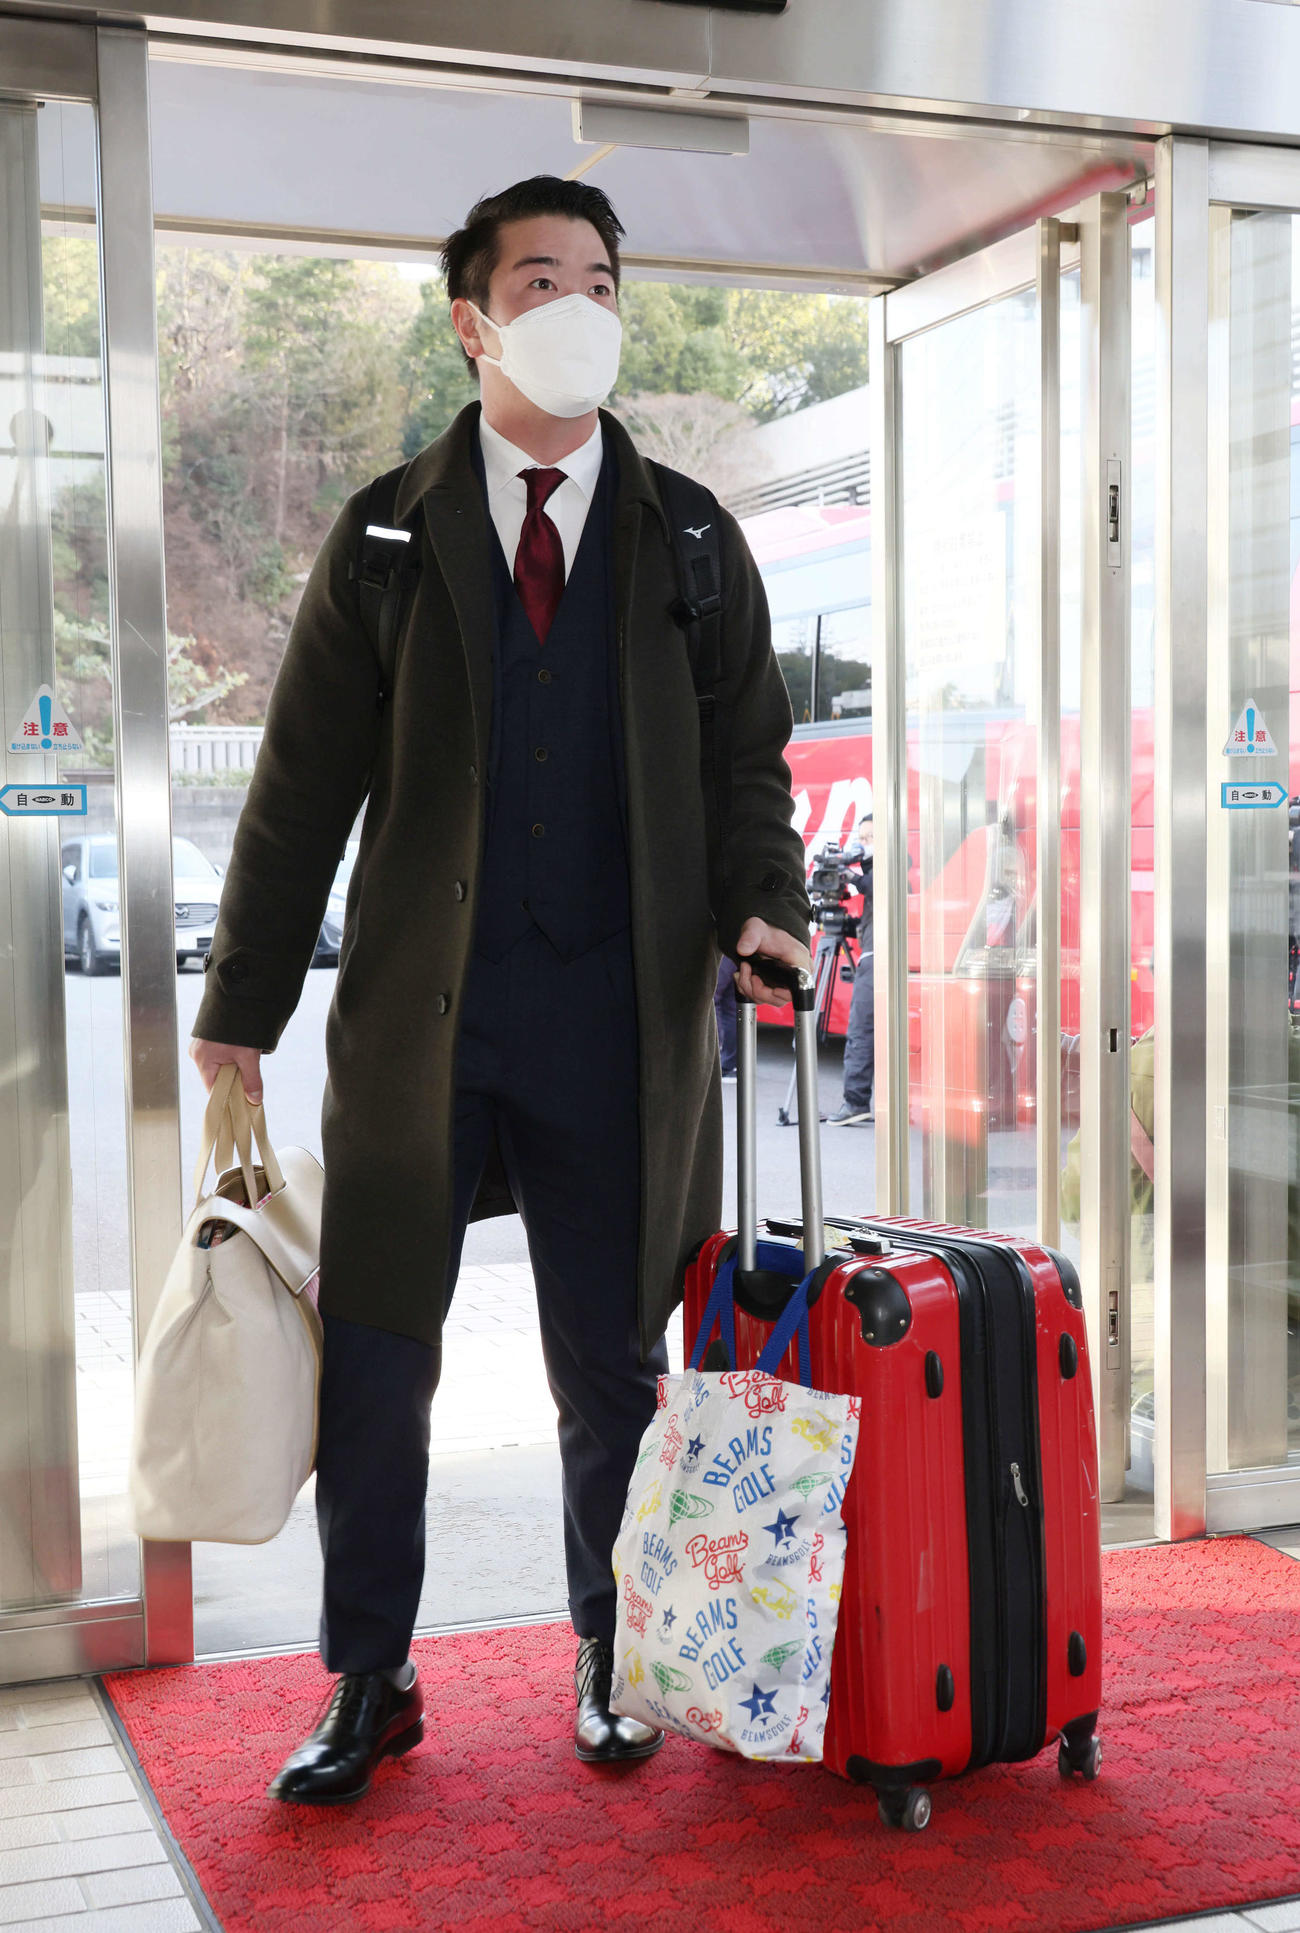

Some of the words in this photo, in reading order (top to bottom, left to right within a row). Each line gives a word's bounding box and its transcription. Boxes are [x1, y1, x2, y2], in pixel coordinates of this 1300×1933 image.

[745, 1384, 789, 1419] Golf
[702, 1425, 773, 1488] BEAMS
[732, 1463, 777, 1514] GOLF
[642, 1531, 678, 1577] BEAMS
[685, 1530, 749, 1568] Beams
[765, 1538, 812, 1567] BEAMSGOLF
[640, 1561, 664, 1597] GOLF
[704, 1552, 746, 1591] Golf
[678, 1597, 738, 1662] BEAMS
[702, 1636, 747, 1691] GOLF
[740, 1714, 793, 1743] BEAMSGOLF
